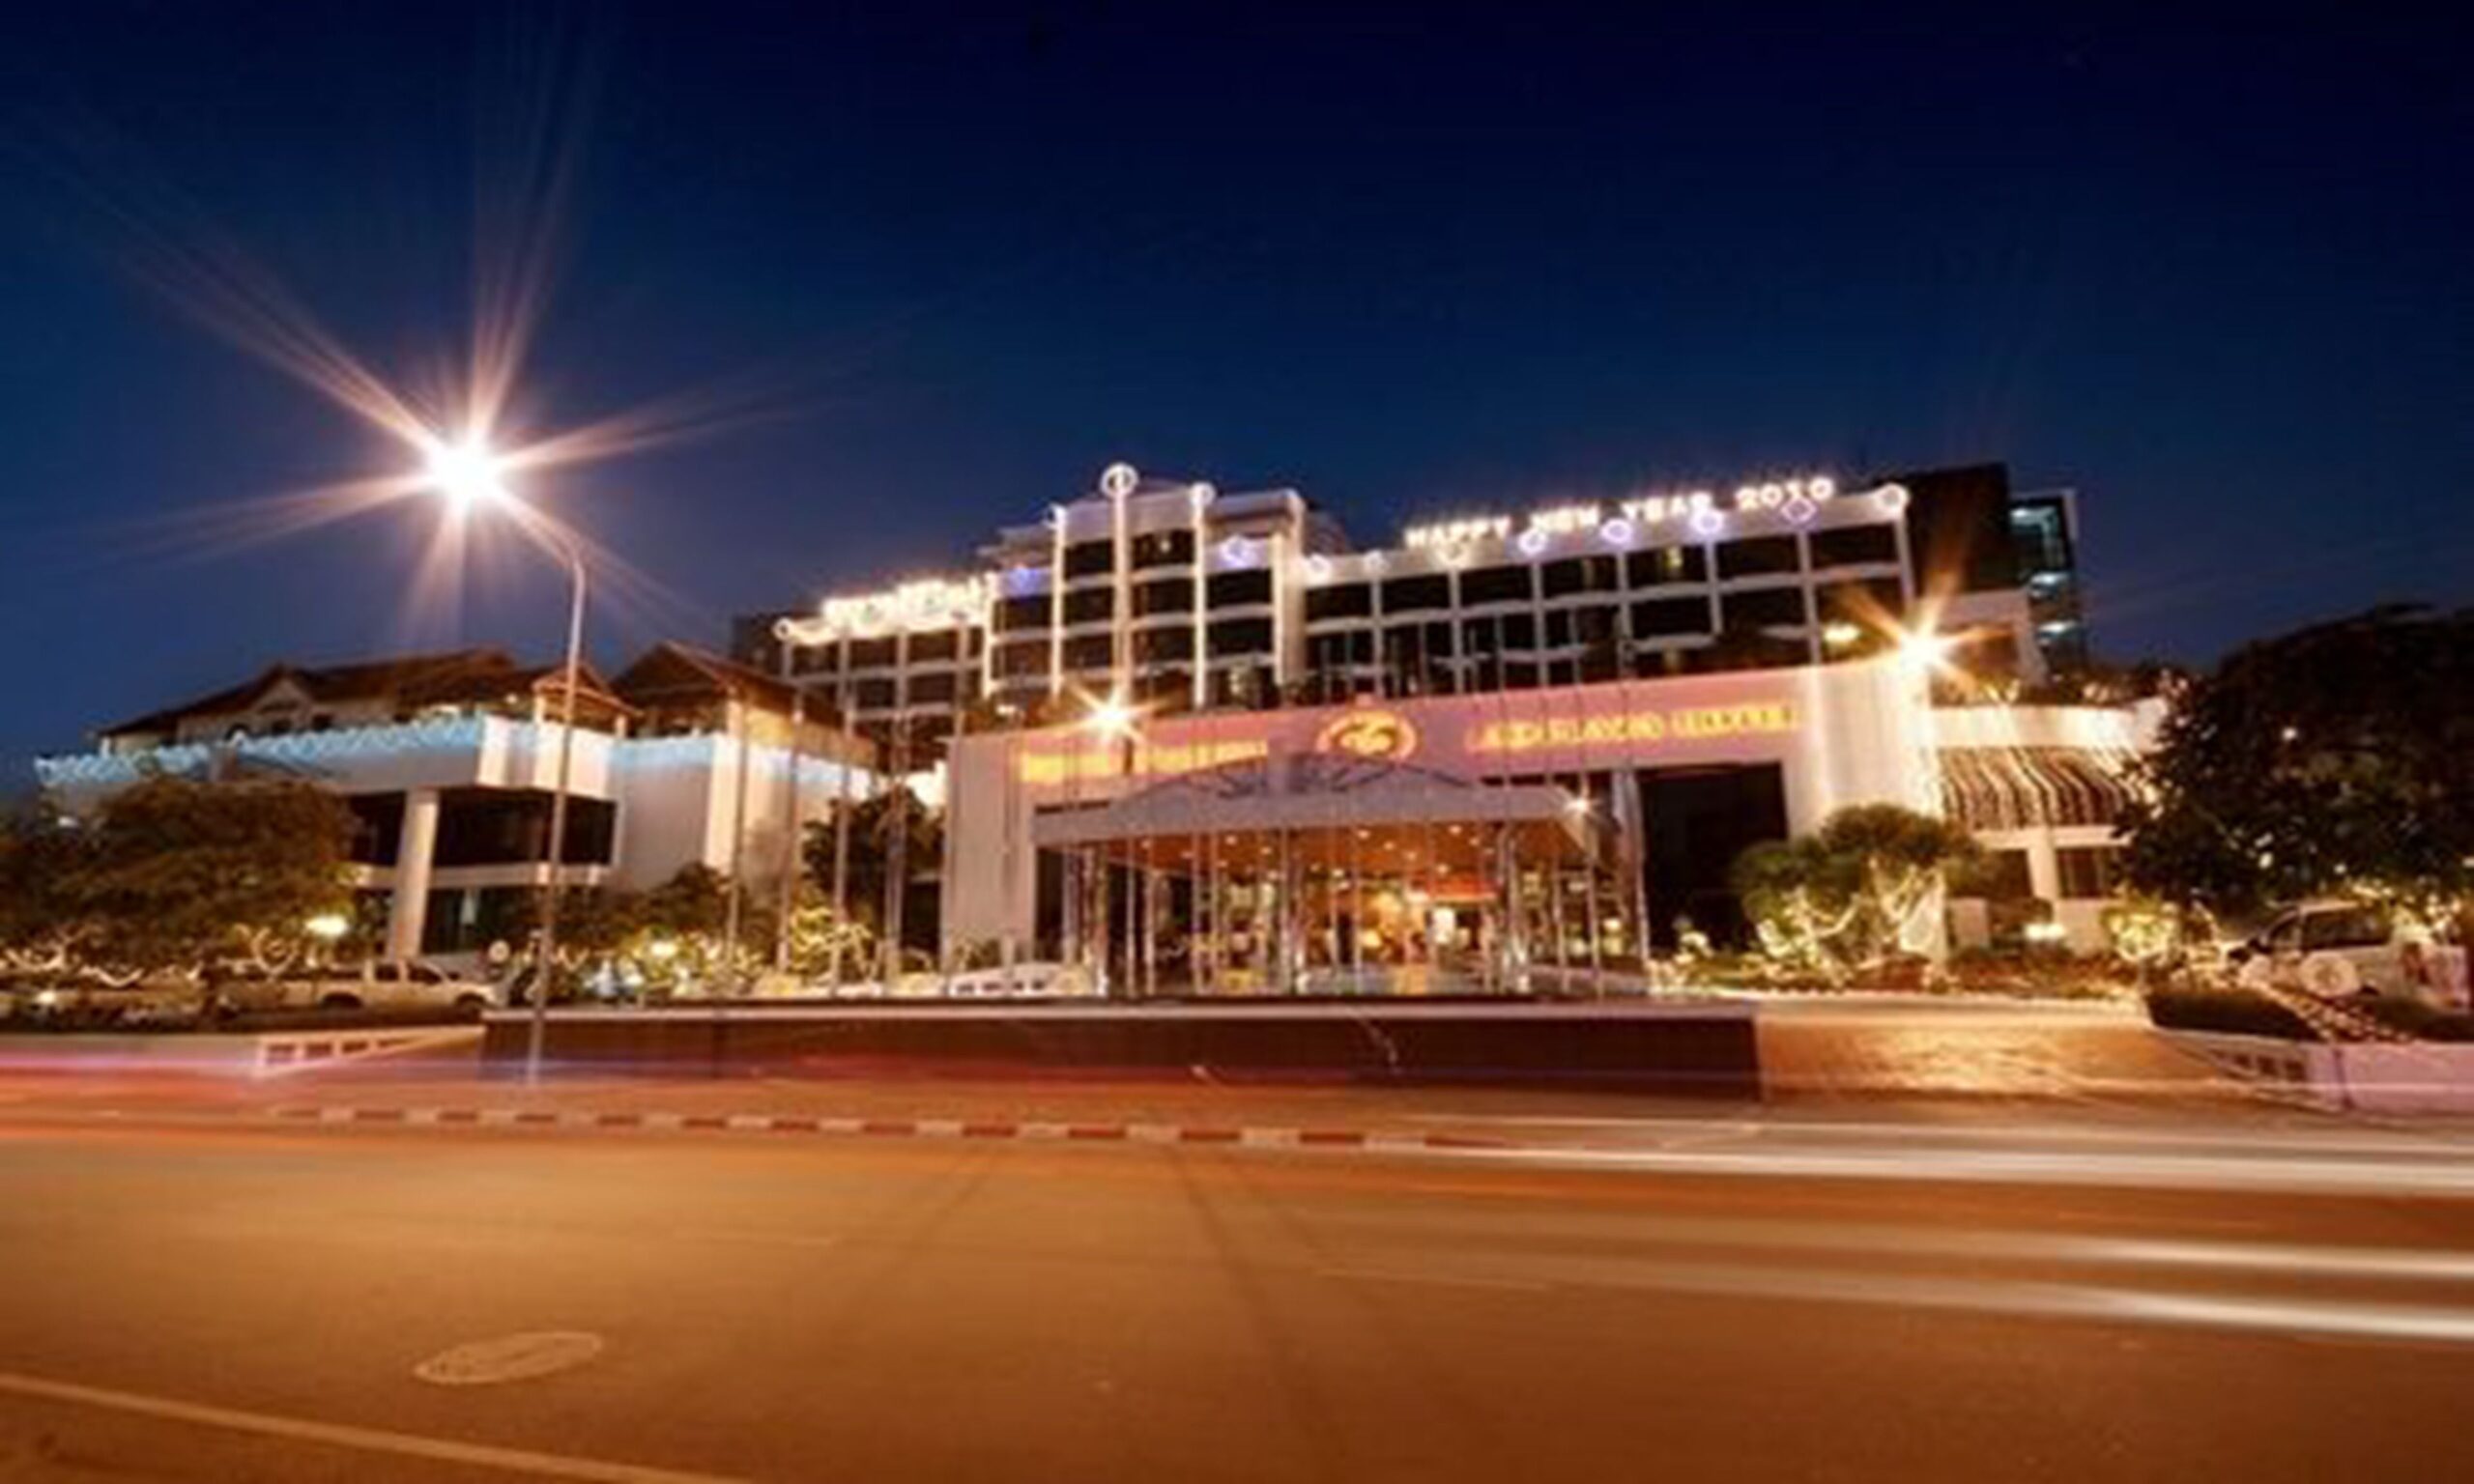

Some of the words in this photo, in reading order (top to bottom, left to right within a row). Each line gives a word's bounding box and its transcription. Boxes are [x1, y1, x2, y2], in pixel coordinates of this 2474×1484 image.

[1405, 514, 1510, 548] HAPPY
[1531, 504, 1599, 532] NEW
[1621, 491, 1712, 522] YEAR
[1735, 477, 1833, 510] 2010
